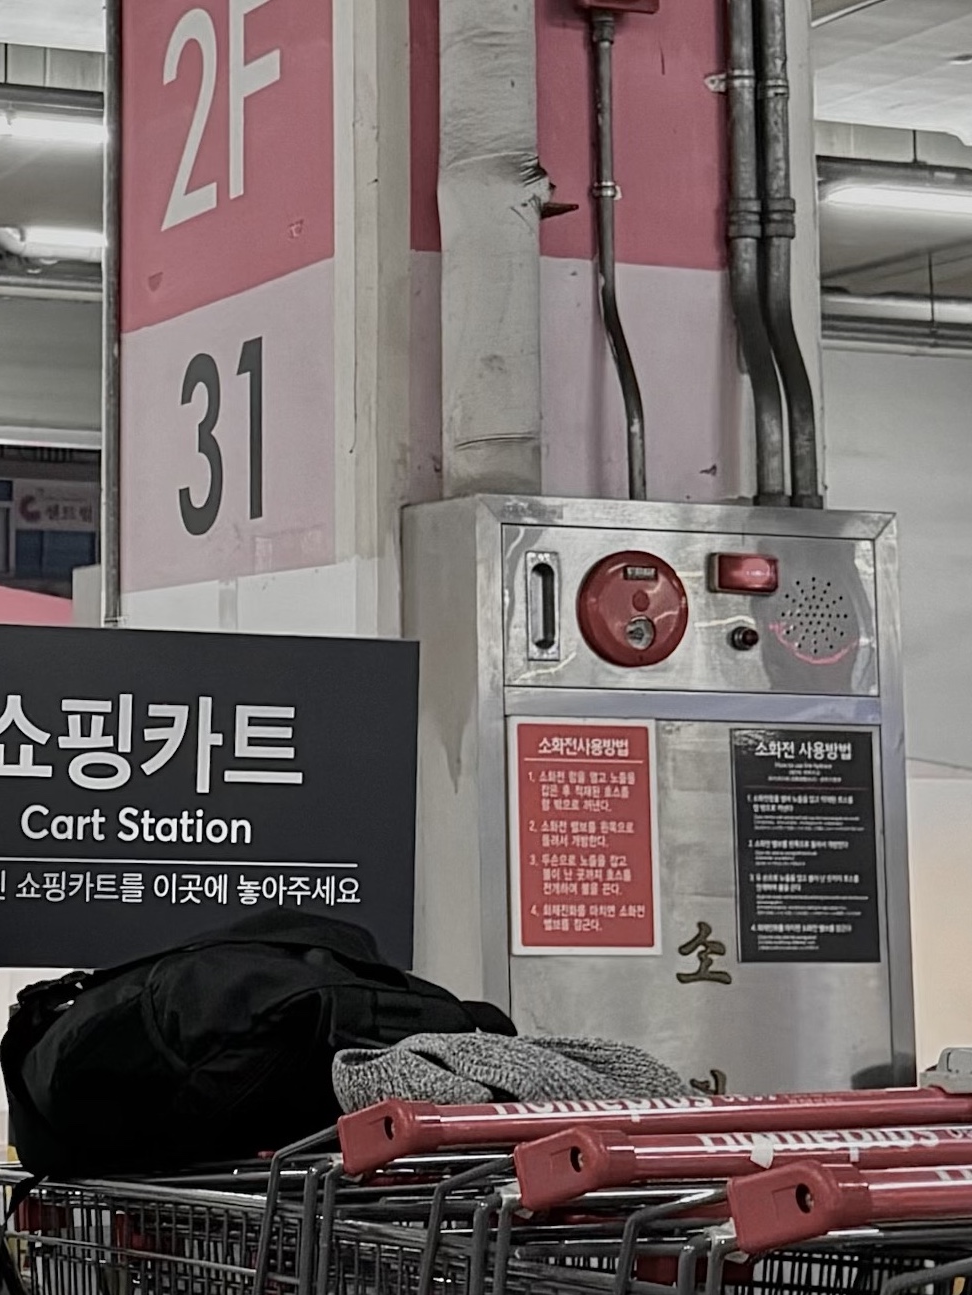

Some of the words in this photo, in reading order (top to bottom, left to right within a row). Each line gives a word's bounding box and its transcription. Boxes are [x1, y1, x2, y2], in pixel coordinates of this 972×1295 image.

[161, 0, 281, 231] 2F
[179, 336, 263, 536] 31
[538, 737, 629, 757] 소화전사용방법
[754, 741, 795, 759] 소화전
[799, 742, 852, 760] 사용방법
[21, 804, 106, 842] Cart
[117, 807, 252, 844] Station
[16, 871, 145, 903] 쇼핑카트를
[153, 873, 229, 905] 이곳에
[237, 874, 362, 906] 놓아주세요
